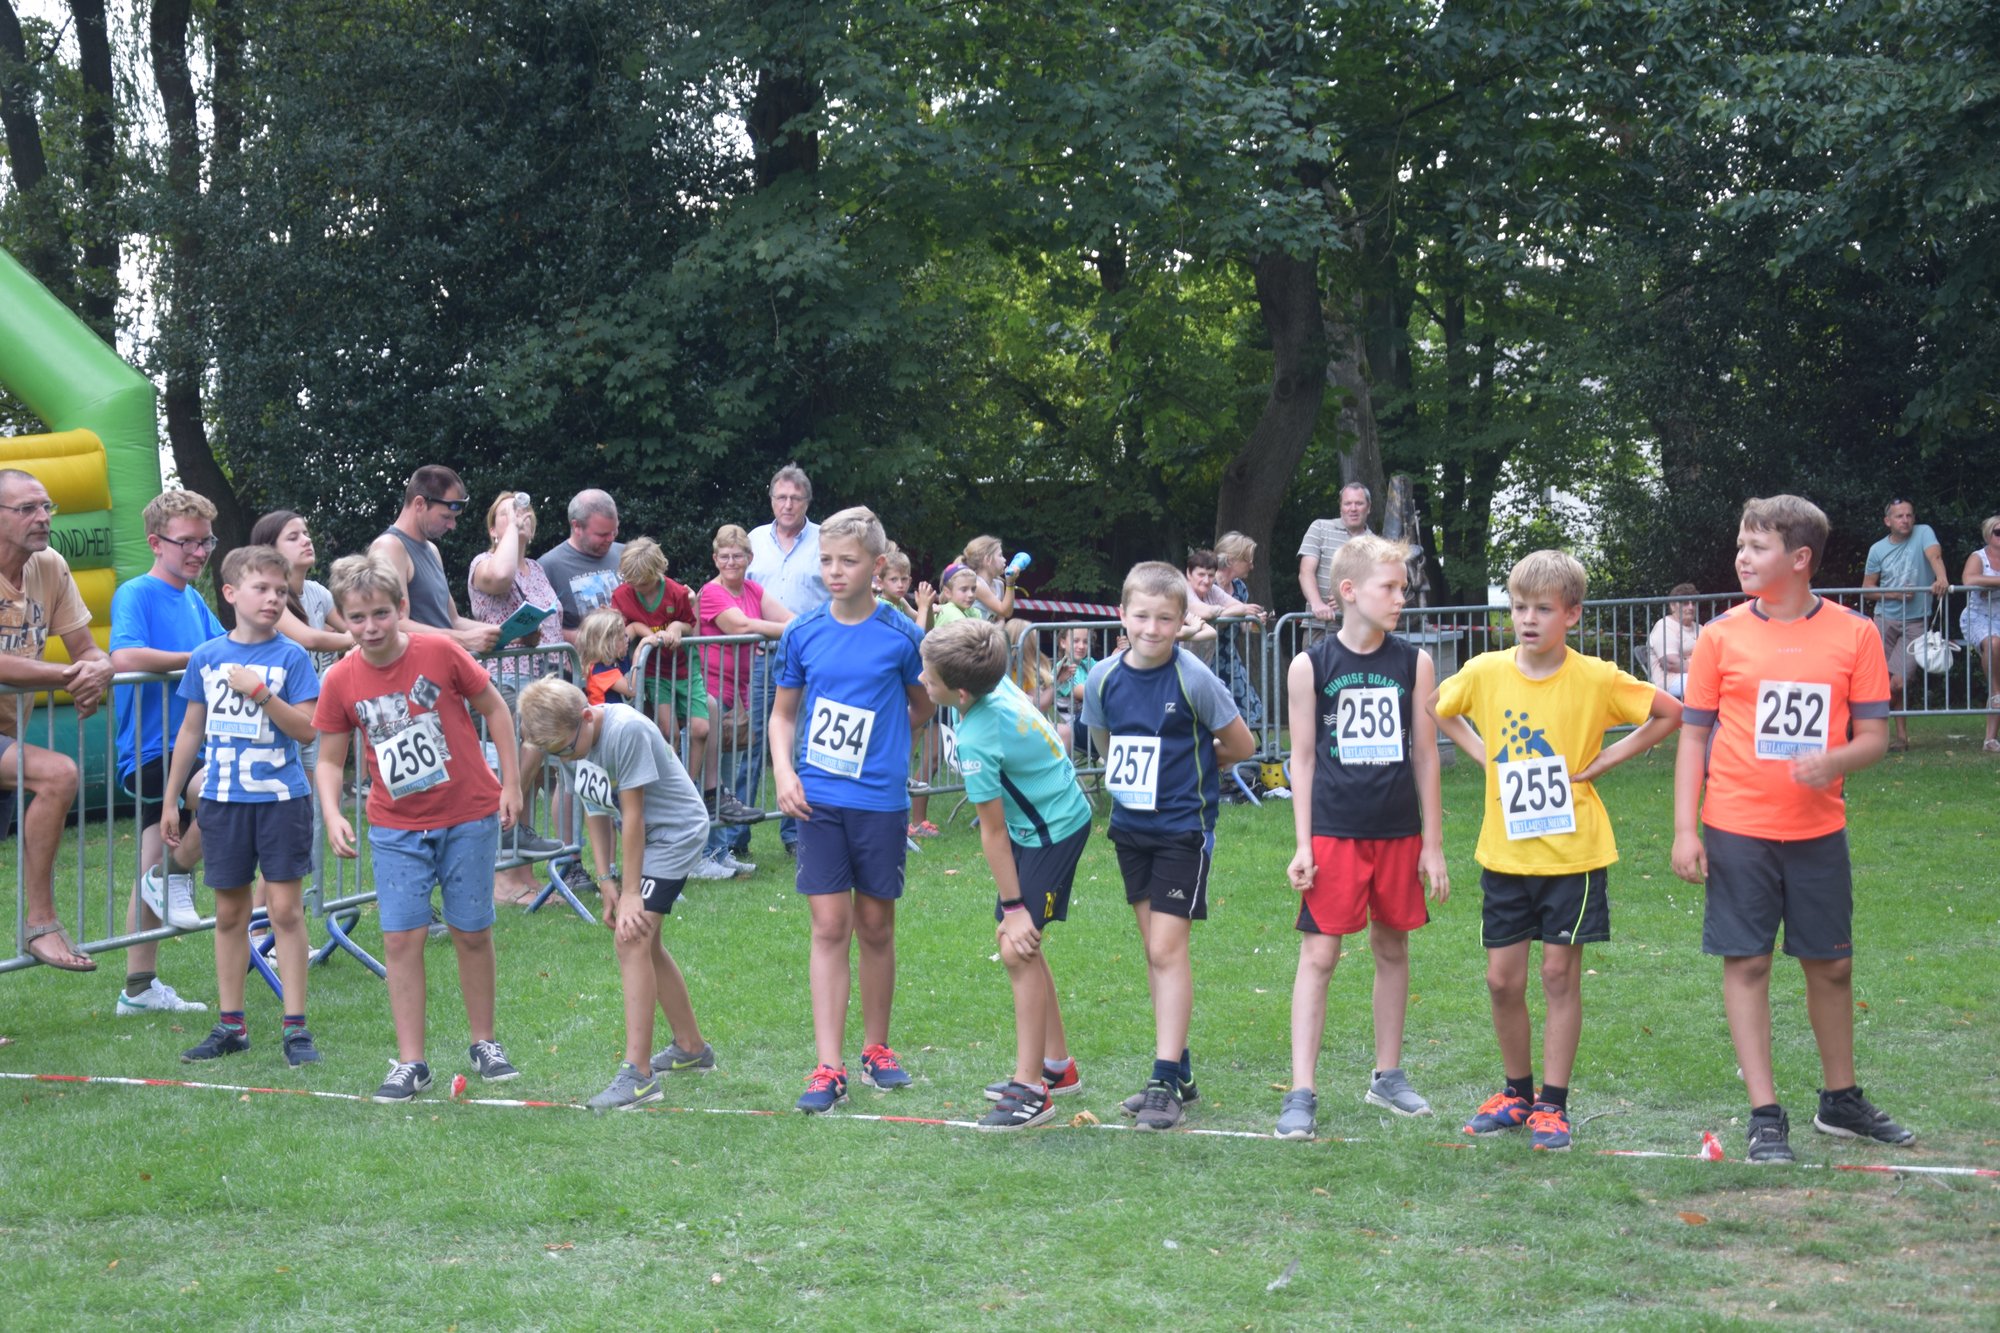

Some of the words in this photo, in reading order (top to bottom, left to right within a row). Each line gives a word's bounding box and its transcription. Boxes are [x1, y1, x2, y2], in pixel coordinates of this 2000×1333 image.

[1324, 673, 1365, 697] SUNRISE
[812, 707, 866, 756] 254
[1341, 696, 1396, 739] 258
[1760, 690, 1824, 738] 252
[383, 732, 437, 785] 256
[1109, 744, 1156, 786] 257
[579, 767, 615, 809] 262
[1505, 765, 1567, 814] 255
